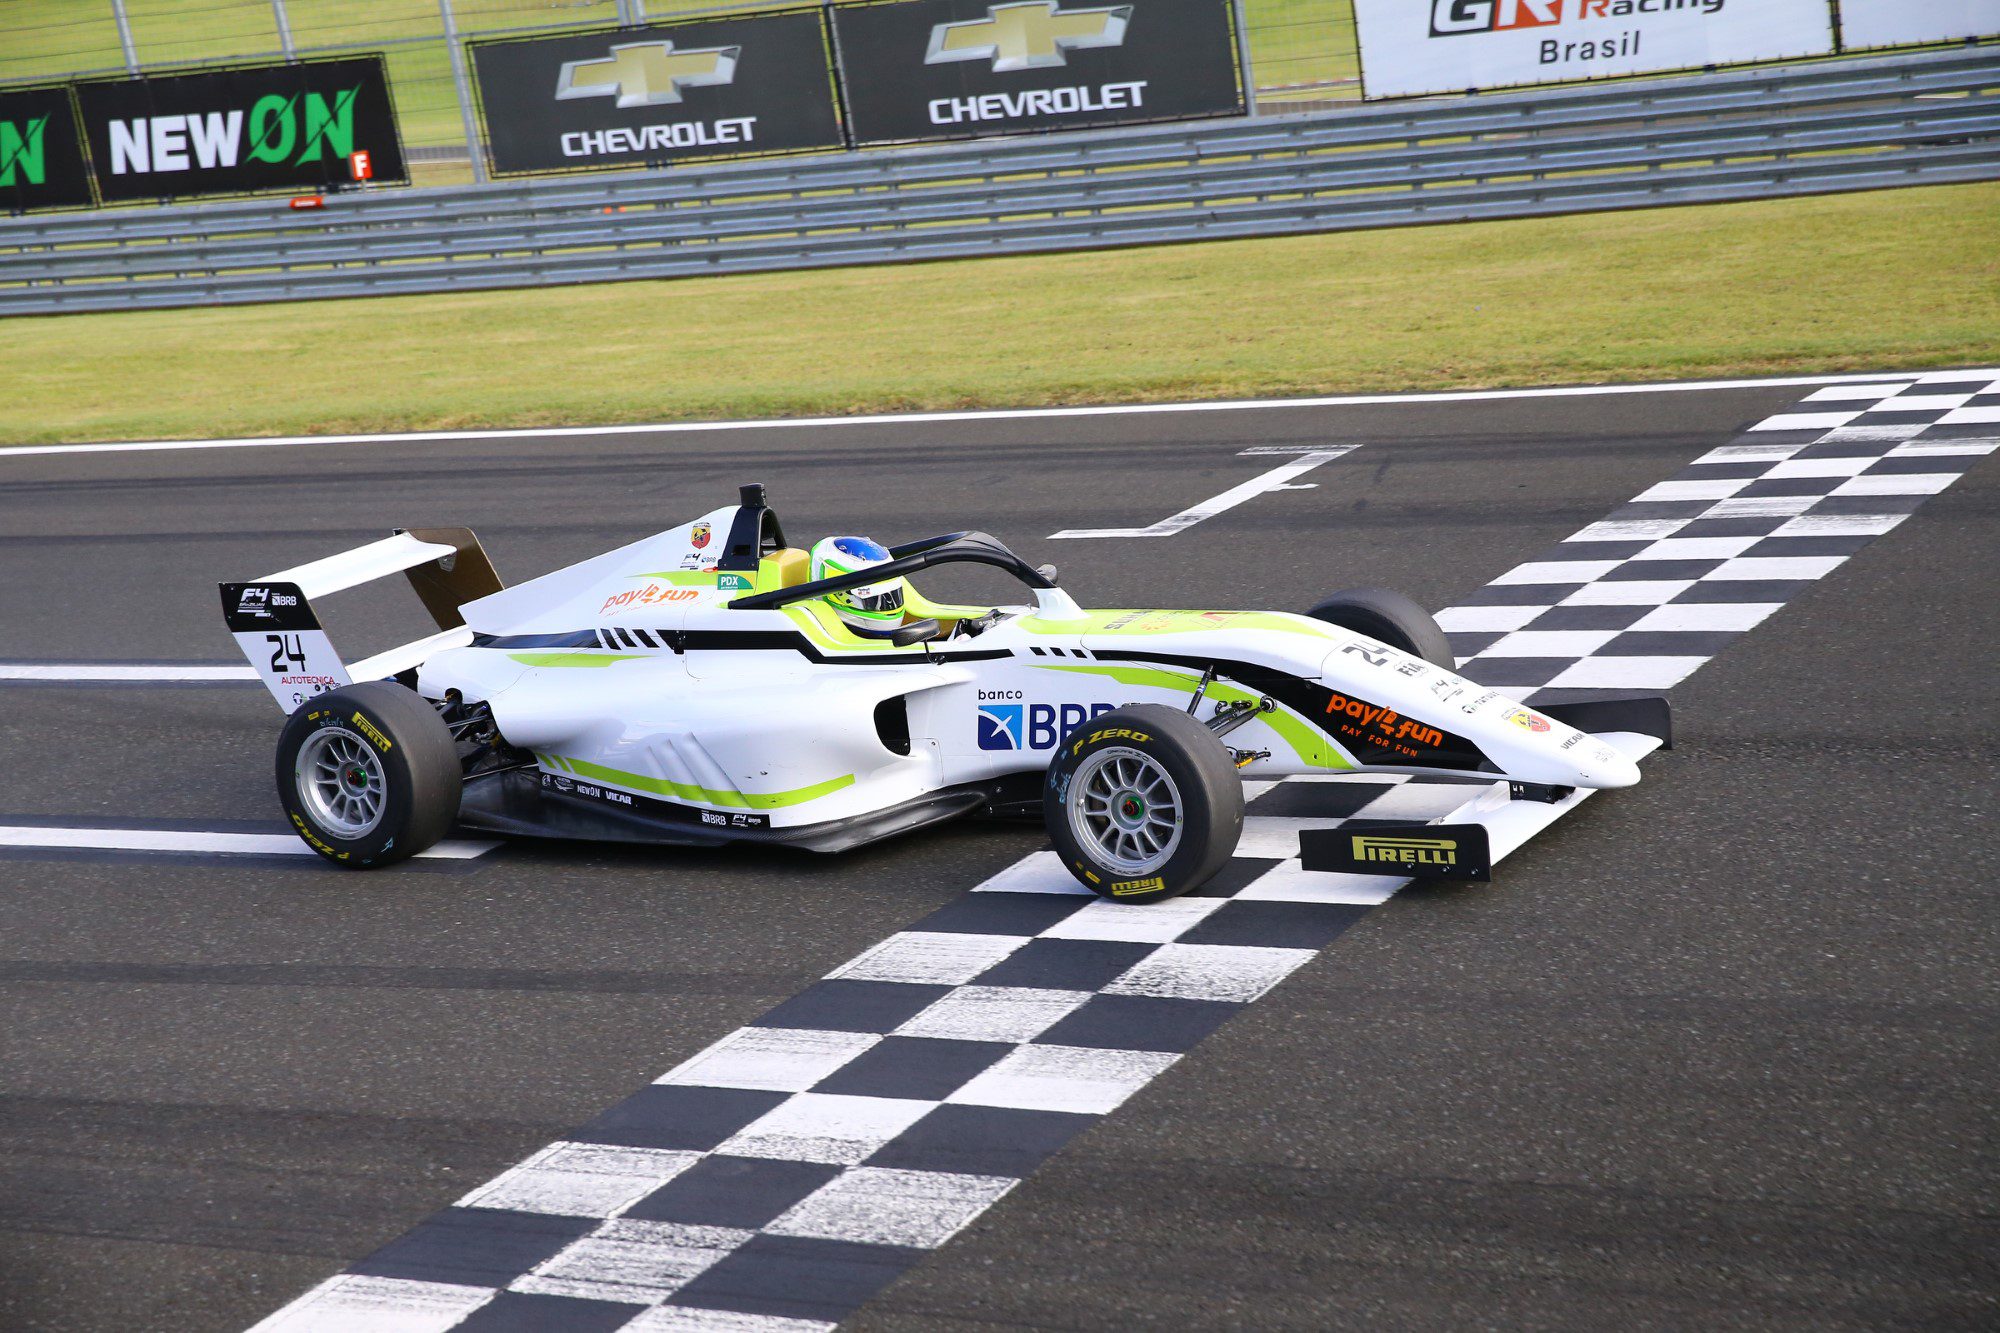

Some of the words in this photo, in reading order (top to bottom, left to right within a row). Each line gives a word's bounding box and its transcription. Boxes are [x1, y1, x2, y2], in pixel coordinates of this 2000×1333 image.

[1539, 30, 1641, 65] Brasil
[927, 80, 1148, 125] CHEVROLET
[560, 116, 757, 157] CHEVROLET
[354, 154, 368, 178] F
[241, 588, 269, 602] F4
[720, 576, 739, 586] PDX
[281, 596, 297, 606] BRB
[266, 634, 306, 673] 24
[281, 676, 336, 685] AUTOTECNICA
[978, 689, 1023, 700] banco
[351, 711, 393, 753] PIRELLI
[1028, 703, 1116, 750] BR
[1341, 724, 1362, 737] PAY
[1367, 734, 1390, 748] FOR
[1395, 744, 1418, 757] FUN
[1072, 739, 1085, 757] P
[1088, 728, 1151, 743] ZERO
[605, 790, 632, 805] VICAR
[290, 810, 336, 855] ZERO
[710, 814, 726, 826] BRB
[732, 814, 747, 822] F4
[1351, 835, 1457, 865] PIRELLI
[1110, 876, 1165, 897] PIRELLI
